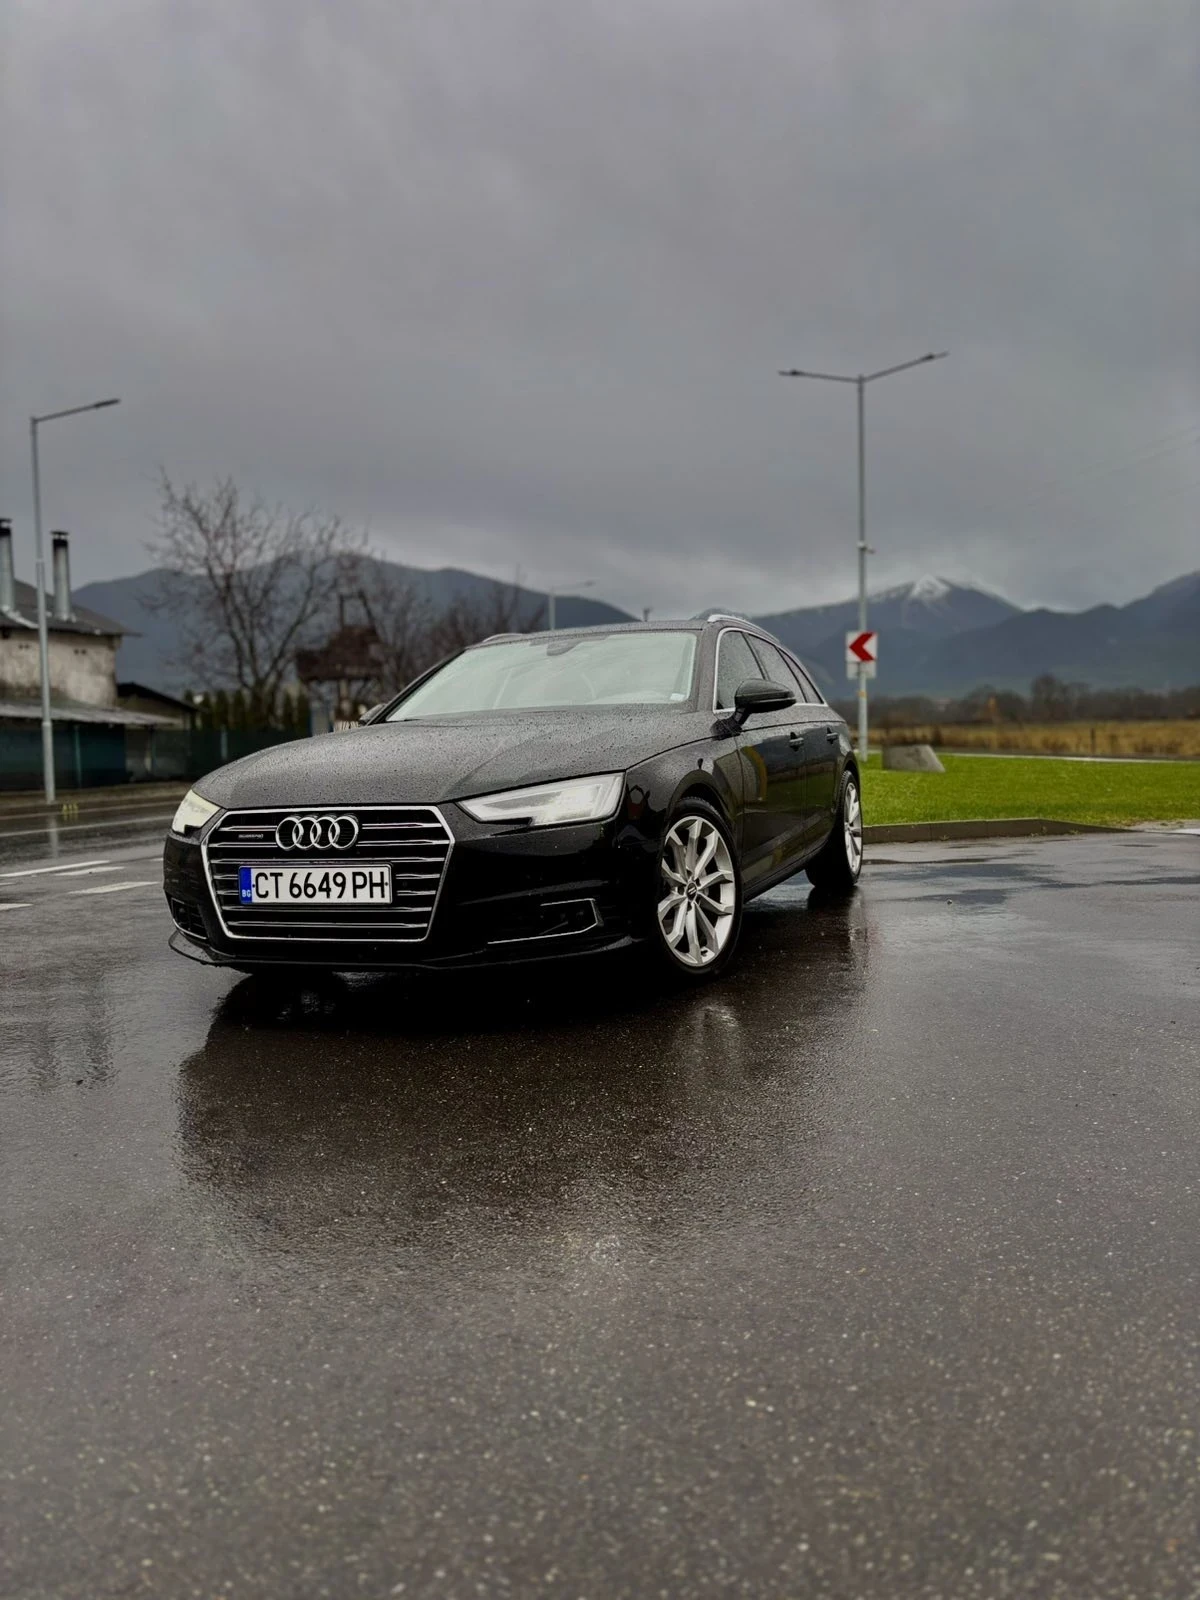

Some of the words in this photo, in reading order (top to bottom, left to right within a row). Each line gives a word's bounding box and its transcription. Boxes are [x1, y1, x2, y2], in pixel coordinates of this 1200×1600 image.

[241, 889, 252, 898] BG
[255, 872, 283, 898] CT
[289, 872, 346, 898] 6649
[352, 871, 385, 898] PH
